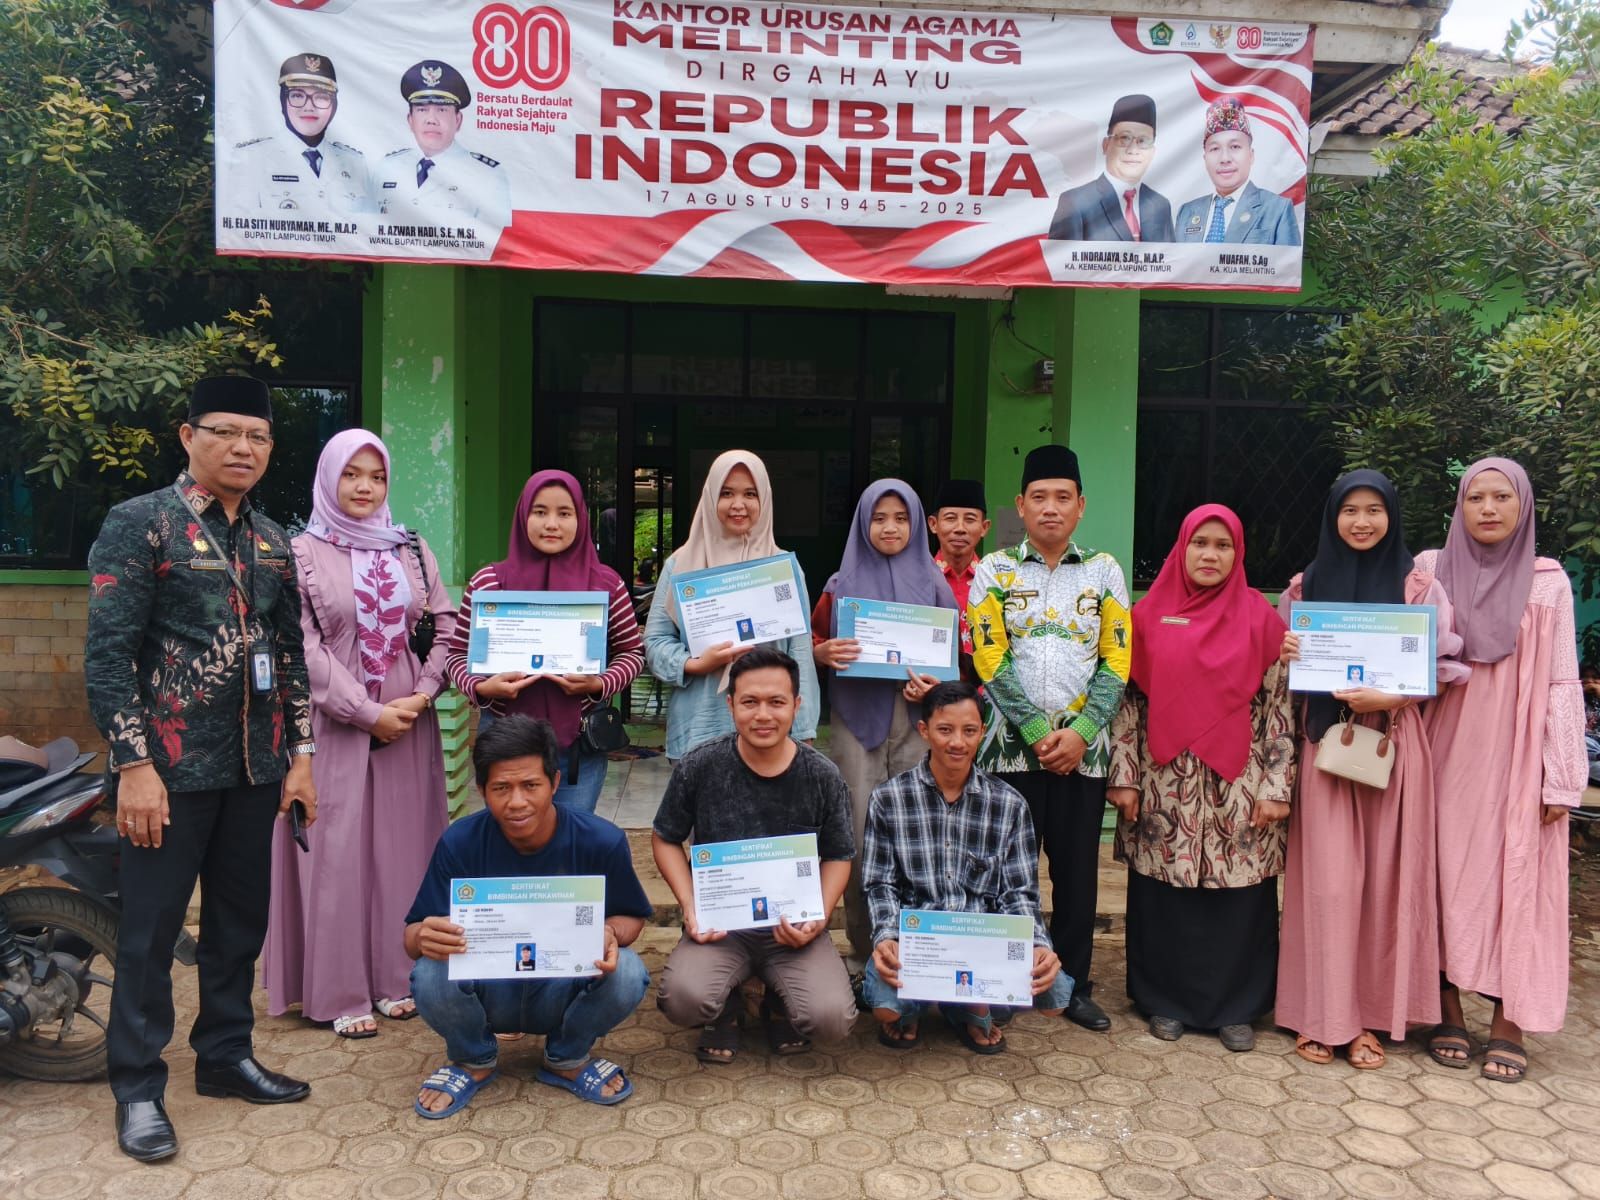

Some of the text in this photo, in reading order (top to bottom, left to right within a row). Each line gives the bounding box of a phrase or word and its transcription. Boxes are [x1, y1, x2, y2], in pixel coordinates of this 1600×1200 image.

[613, 0, 1022, 38] KANTOR URUSAN AGAMA
[613, 20, 1022, 65] MELINTING
[1237, 26, 1262, 49] 80
[472, 3, 571, 91] 80
[686, 60, 951, 89] DIRGAHAYU
[477, 92, 573, 107] Bersatu Berdaulat
[477, 105, 567, 120] Rakyat Sejahtera
[599, 88, 1030, 146] REPUBLIK
[477, 119, 555, 135] Indonesia Maju
[574, 133, 1049, 199] INDONESIA
[645, 190, 670, 204] 17
[686, 192, 810, 209] AGUSTUS
[826, 197, 887, 212] 1945
[919, 200, 983, 216] 2025
[223, 217, 234, 229] Hj.
[236, 217, 250, 230] ELA
[251, 218, 268, 230] SITI
[335, 222, 358, 235] M.A.P.
[378, 225, 386, 236] H.
[388, 225, 416, 237] AZWAR
[417, 226, 439, 238] HADI,
[244, 231, 336, 243] BUPATI LAMPUNG TIMUR
[369, 236, 485, 249] WAKIL BUPATI LAMPUNG TIMUR
[1072, 251, 1079, 262] H.
[1252, 255, 1268, 267] S.Ag
[1113, 264, 1148, 272] LAMPUNG
[1239, 266, 1276, 275] MELINTING
[511, 882, 550, 890] SERTIFIKAT
[487, 892, 575, 901] BIMBINGAN PERKAWINAN
[951, 916, 985, 925] SERTIFIKAT
